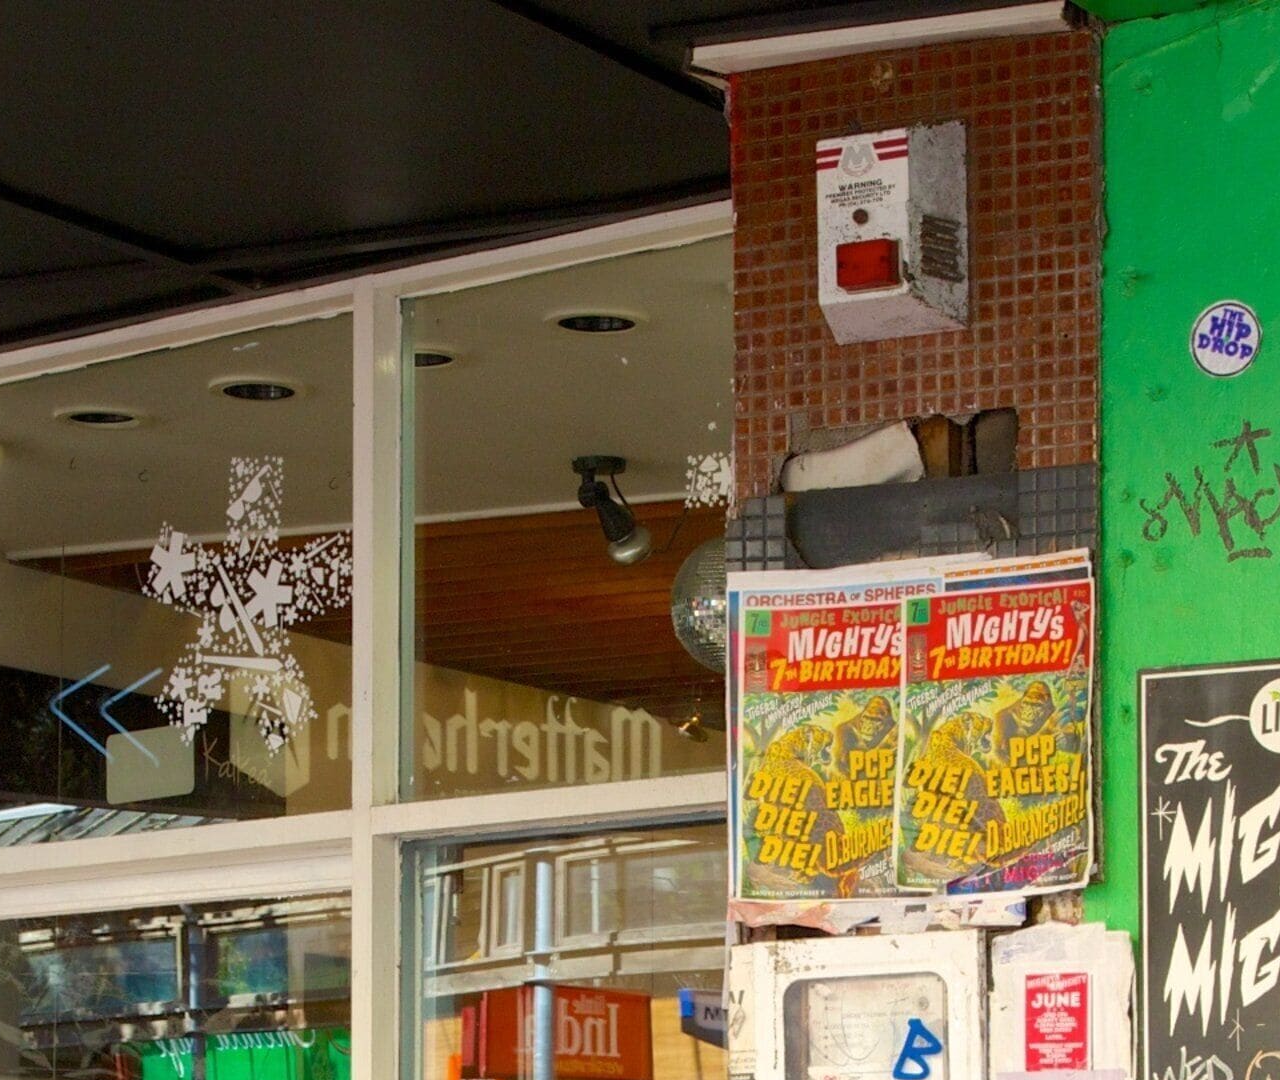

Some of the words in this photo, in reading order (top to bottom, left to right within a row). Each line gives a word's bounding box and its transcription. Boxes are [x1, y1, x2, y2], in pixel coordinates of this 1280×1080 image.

[839, 179, 883, 191] WARNING
[1223, 308, 1245, 322] THE
[1210, 316, 1251, 342] HIP
[1197, 334, 1253, 359] DROP
[747, 591, 847, 607] ORCHESTRA
[1009, 735, 1056, 768] PCP
[1155, 740, 1232, 784] The
[1031, 992, 1081, 1009] JUNE
